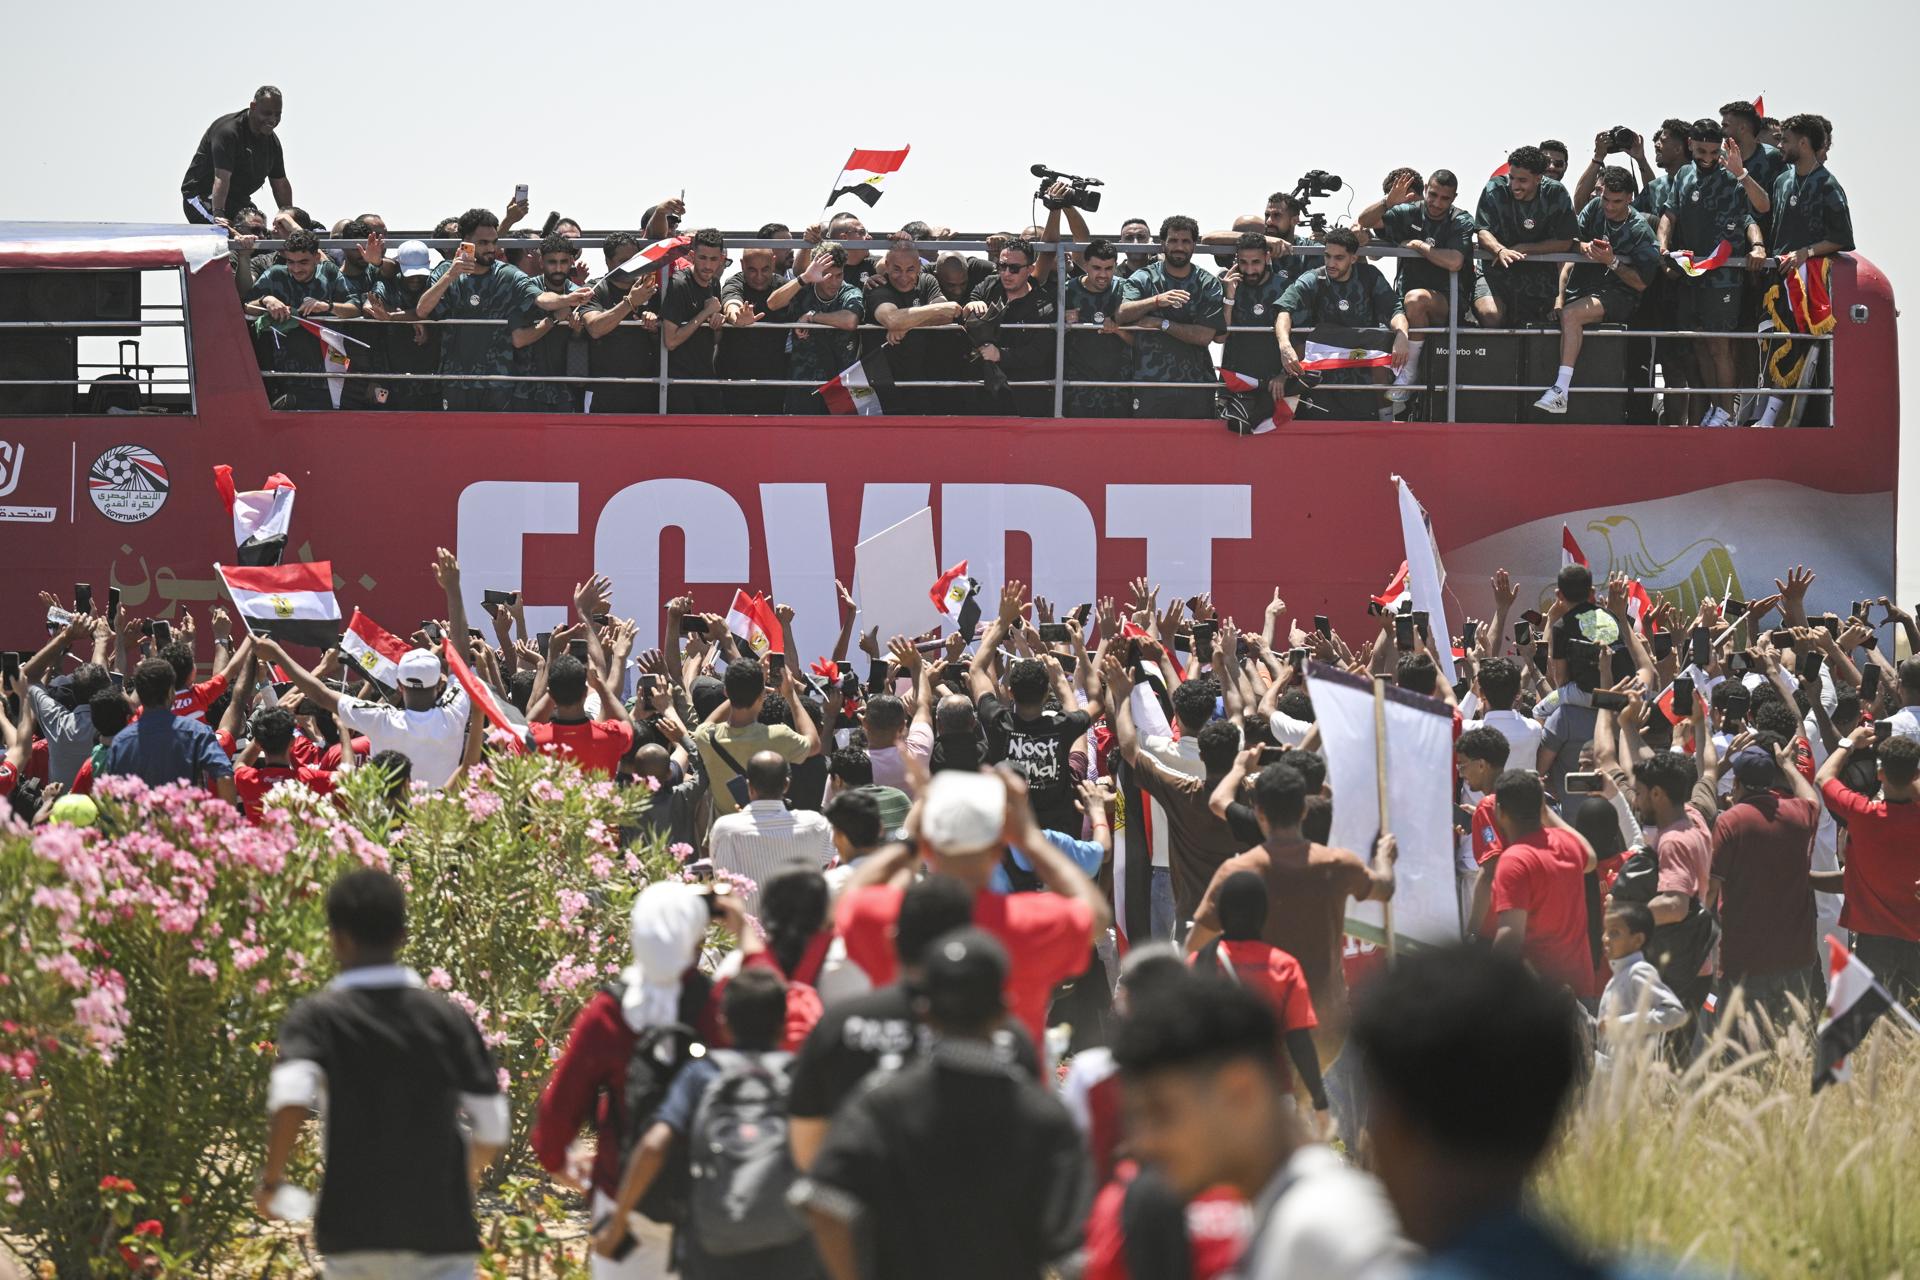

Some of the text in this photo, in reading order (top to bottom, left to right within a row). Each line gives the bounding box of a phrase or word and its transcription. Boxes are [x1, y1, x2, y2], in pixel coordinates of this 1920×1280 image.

[106, 509, 148, 520] EGYPTIAN FA
[1009, 737, 1059, 760] Noct
